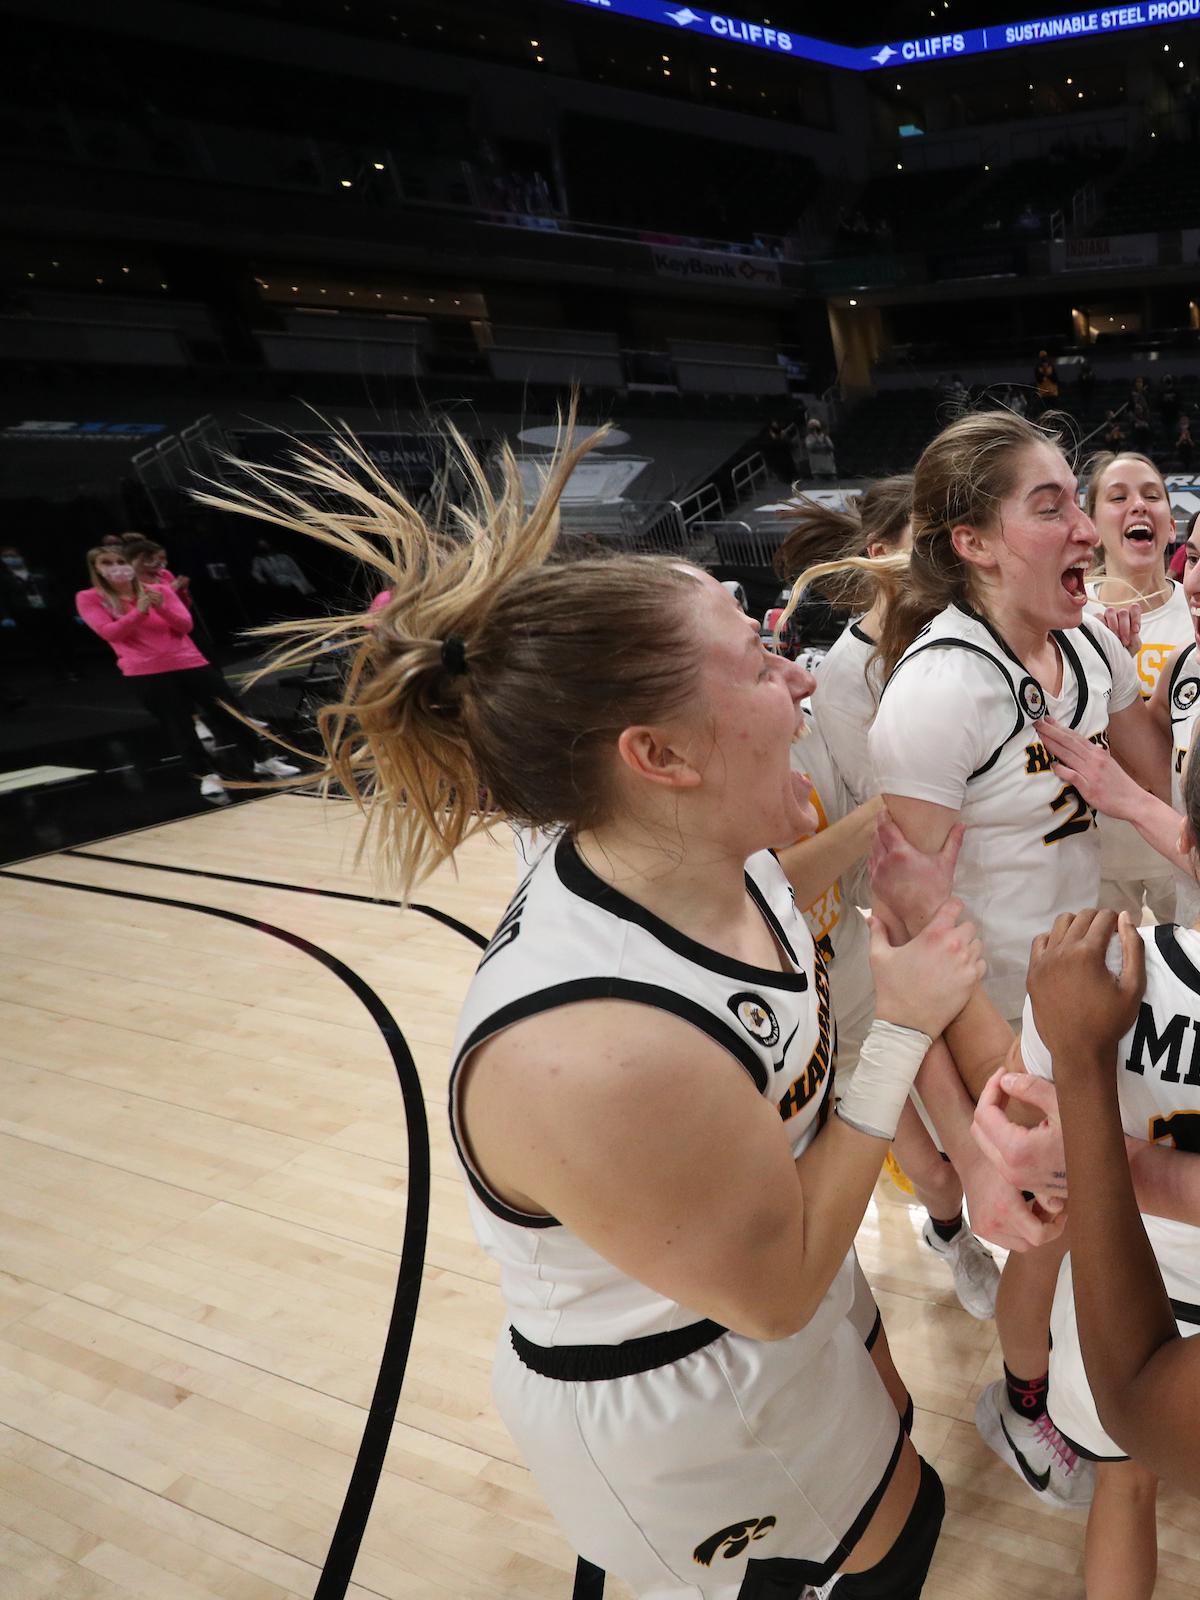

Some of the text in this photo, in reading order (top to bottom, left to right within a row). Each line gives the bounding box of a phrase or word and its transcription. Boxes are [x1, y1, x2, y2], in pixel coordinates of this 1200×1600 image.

[709, 15, 793, 51] CLIFFS
[901, 34, 965, 60] CLIFFS
[1005, 13, 1099, 43] SUSTAINABLE
[1101, 10, 1146, 28] STEEL
[1066, 239, 1110, 258] INDIANA
[654, 253, 736, 279] KeyBank
